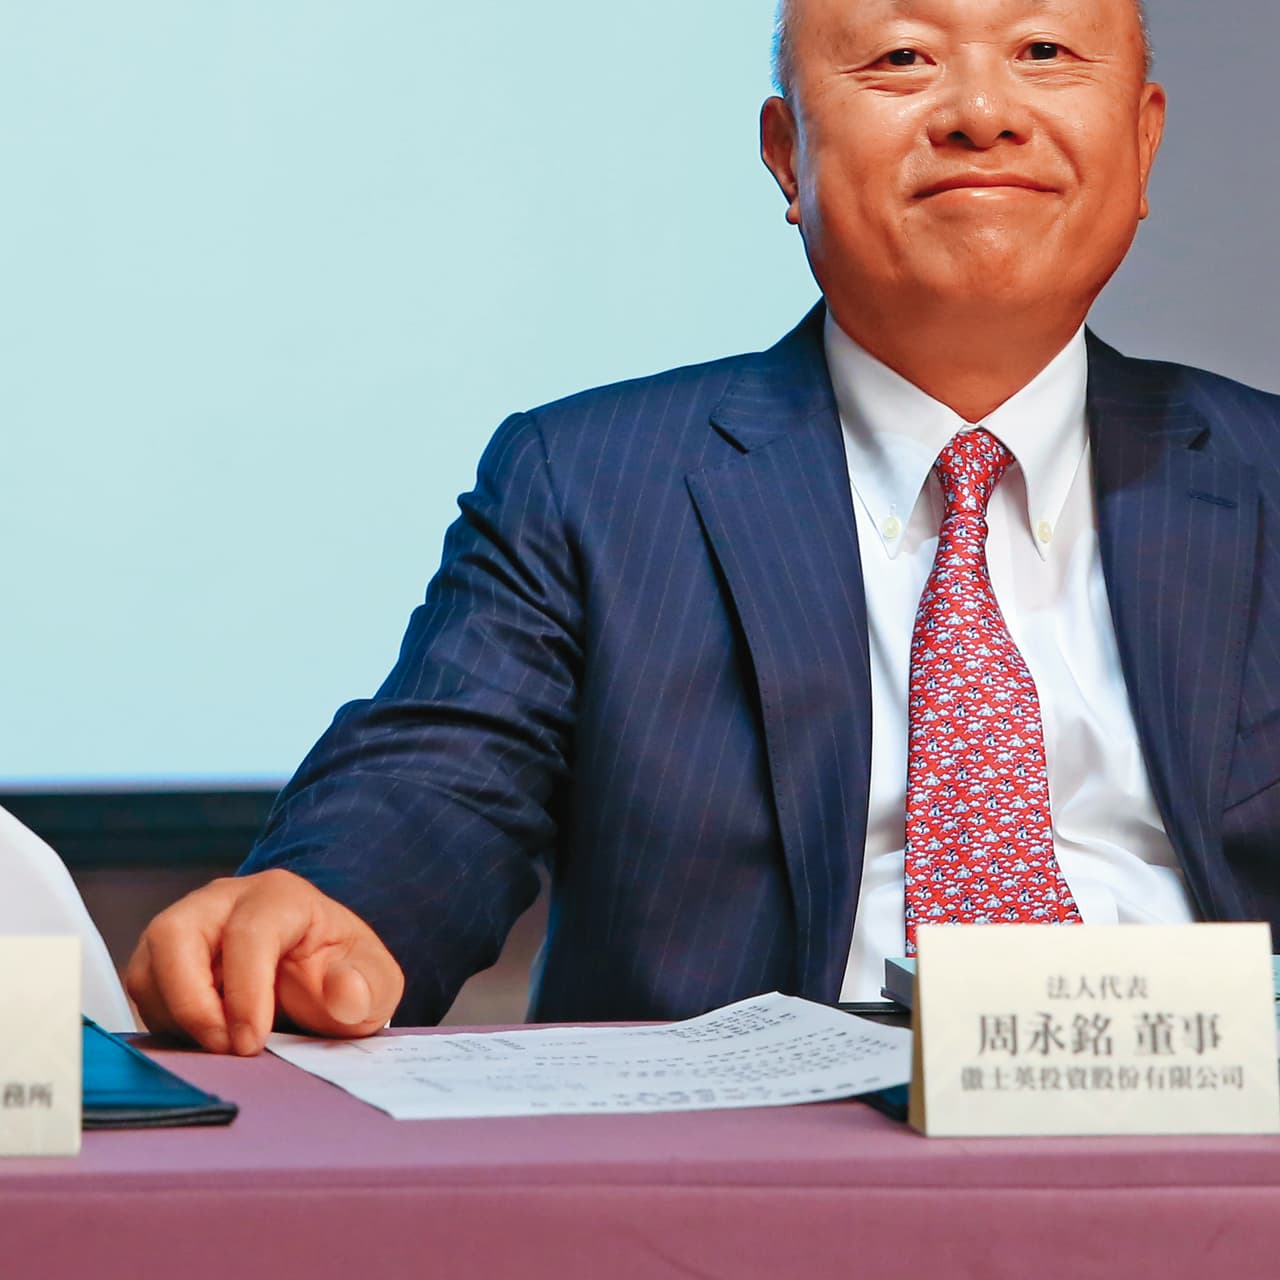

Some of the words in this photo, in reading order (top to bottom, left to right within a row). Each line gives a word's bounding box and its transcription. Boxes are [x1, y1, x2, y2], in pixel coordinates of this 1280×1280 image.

[1046, 975, 1150, 1001] 法人代表
[977, 1011, 1114, 1057] 周永銘
[1133, 1011, 1223, 1056] 董事
